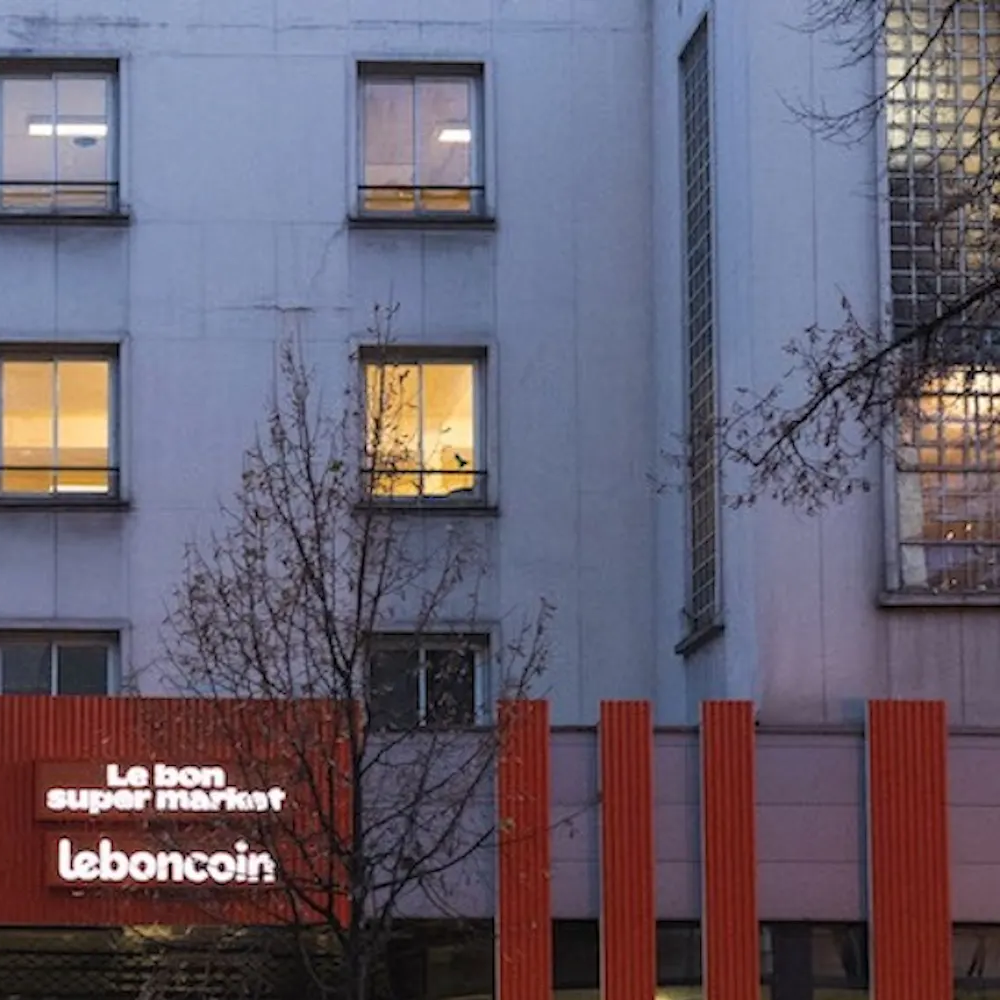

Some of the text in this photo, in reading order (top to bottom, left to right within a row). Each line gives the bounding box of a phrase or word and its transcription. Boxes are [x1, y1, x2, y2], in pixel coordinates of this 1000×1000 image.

[106, 764, 226, 787] Le bon
[46, 787, 287, 815] super market
[58, 837, 276, 882] leboncoin
